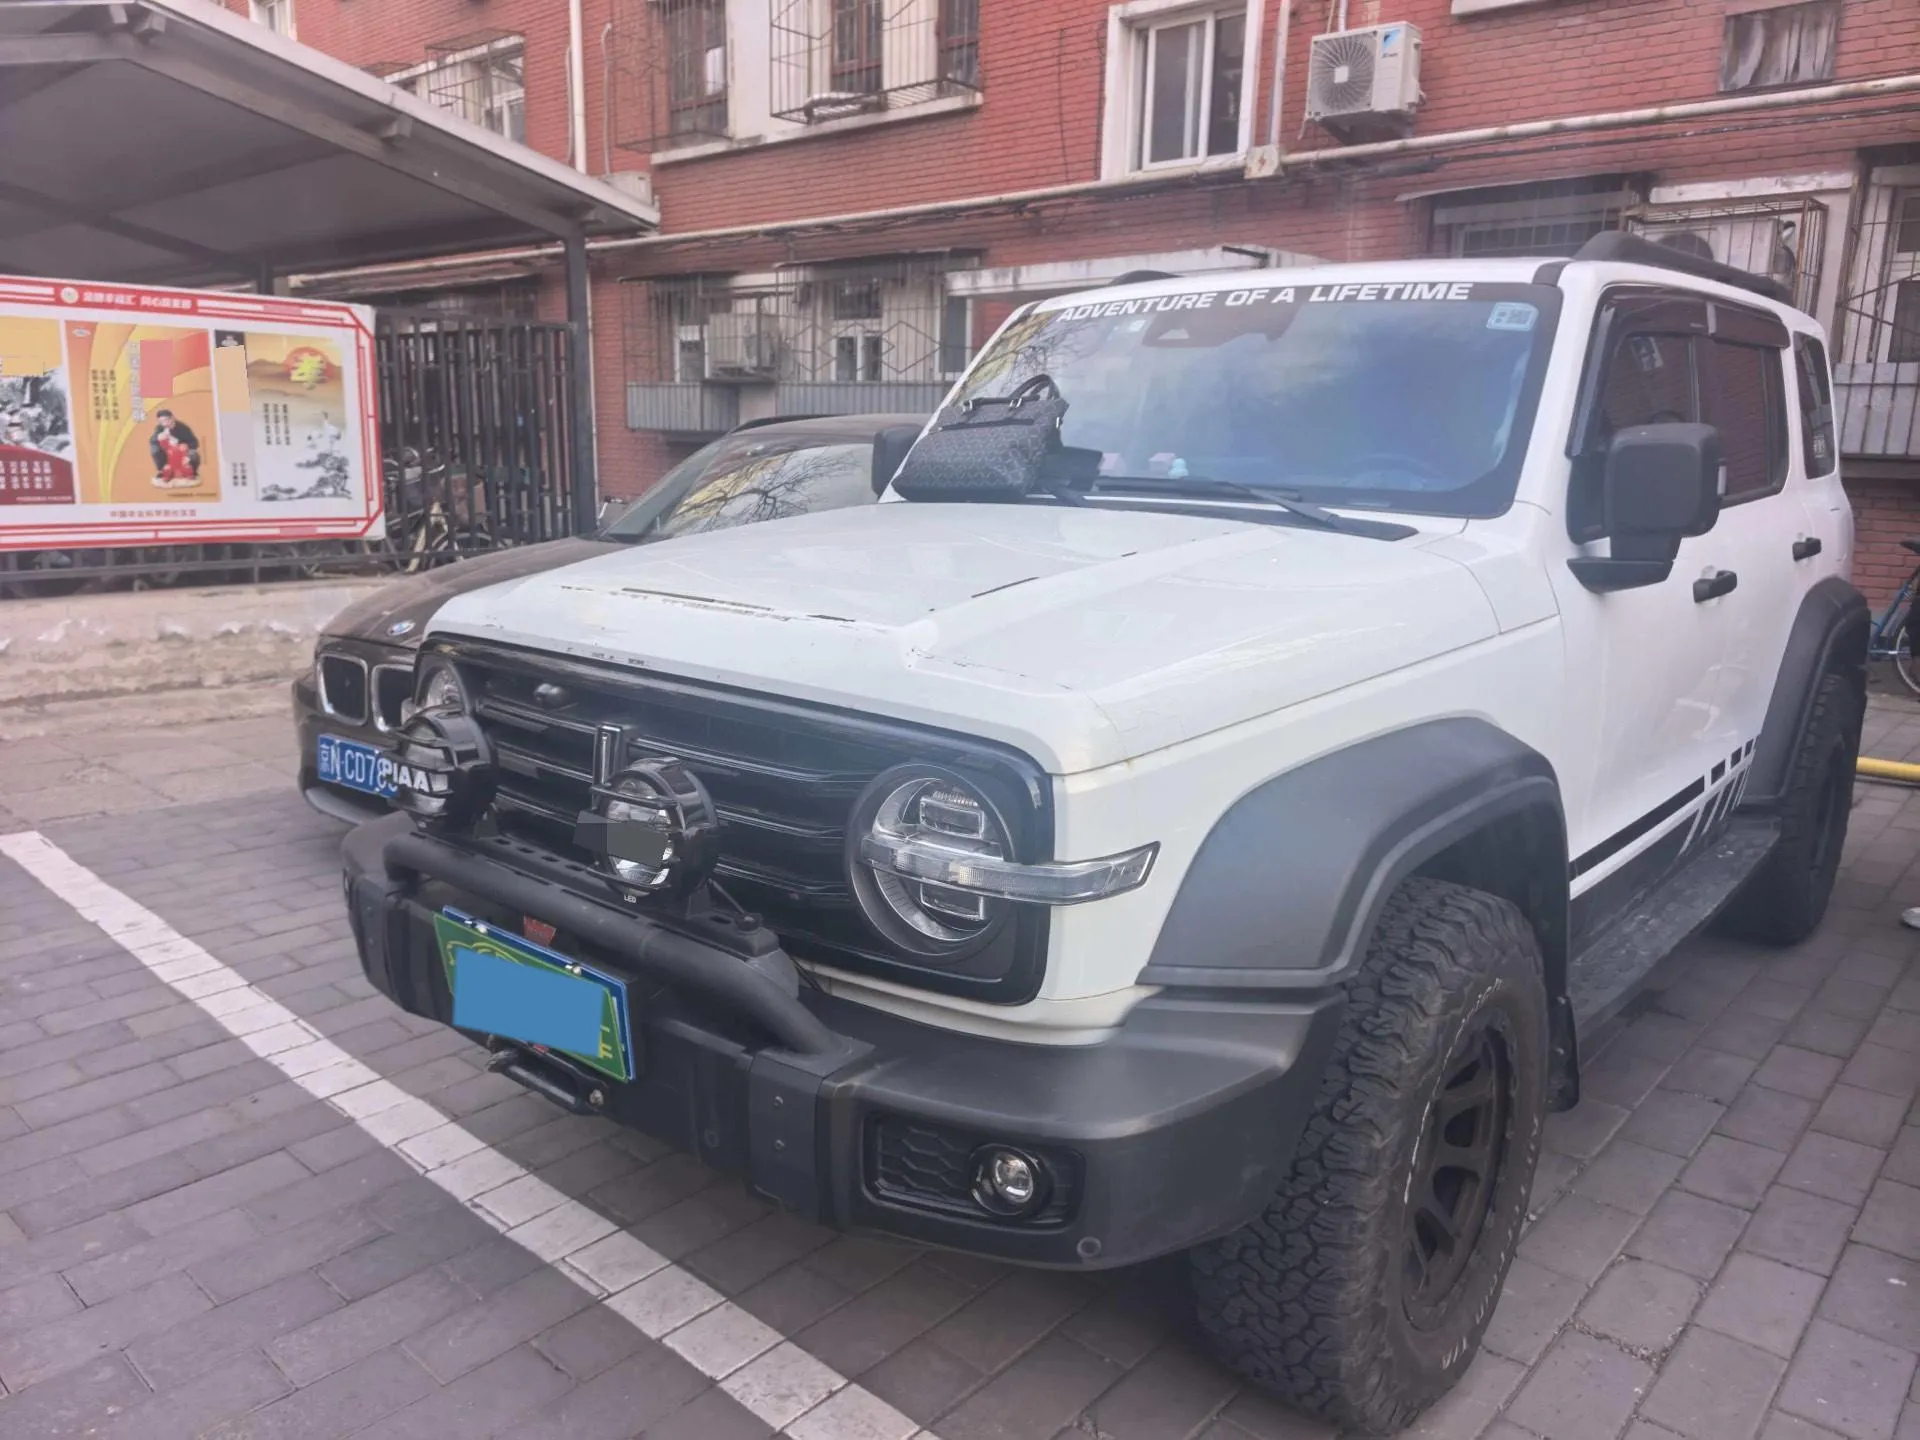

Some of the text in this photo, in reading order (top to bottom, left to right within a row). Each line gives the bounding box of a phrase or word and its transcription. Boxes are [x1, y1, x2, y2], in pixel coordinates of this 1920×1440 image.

[1055, 282, 1474, 322] ADVENTURE OF A LIFETIME
[383, 758, 430, 793] PIAA
[623, 893, 637, 904] LED
